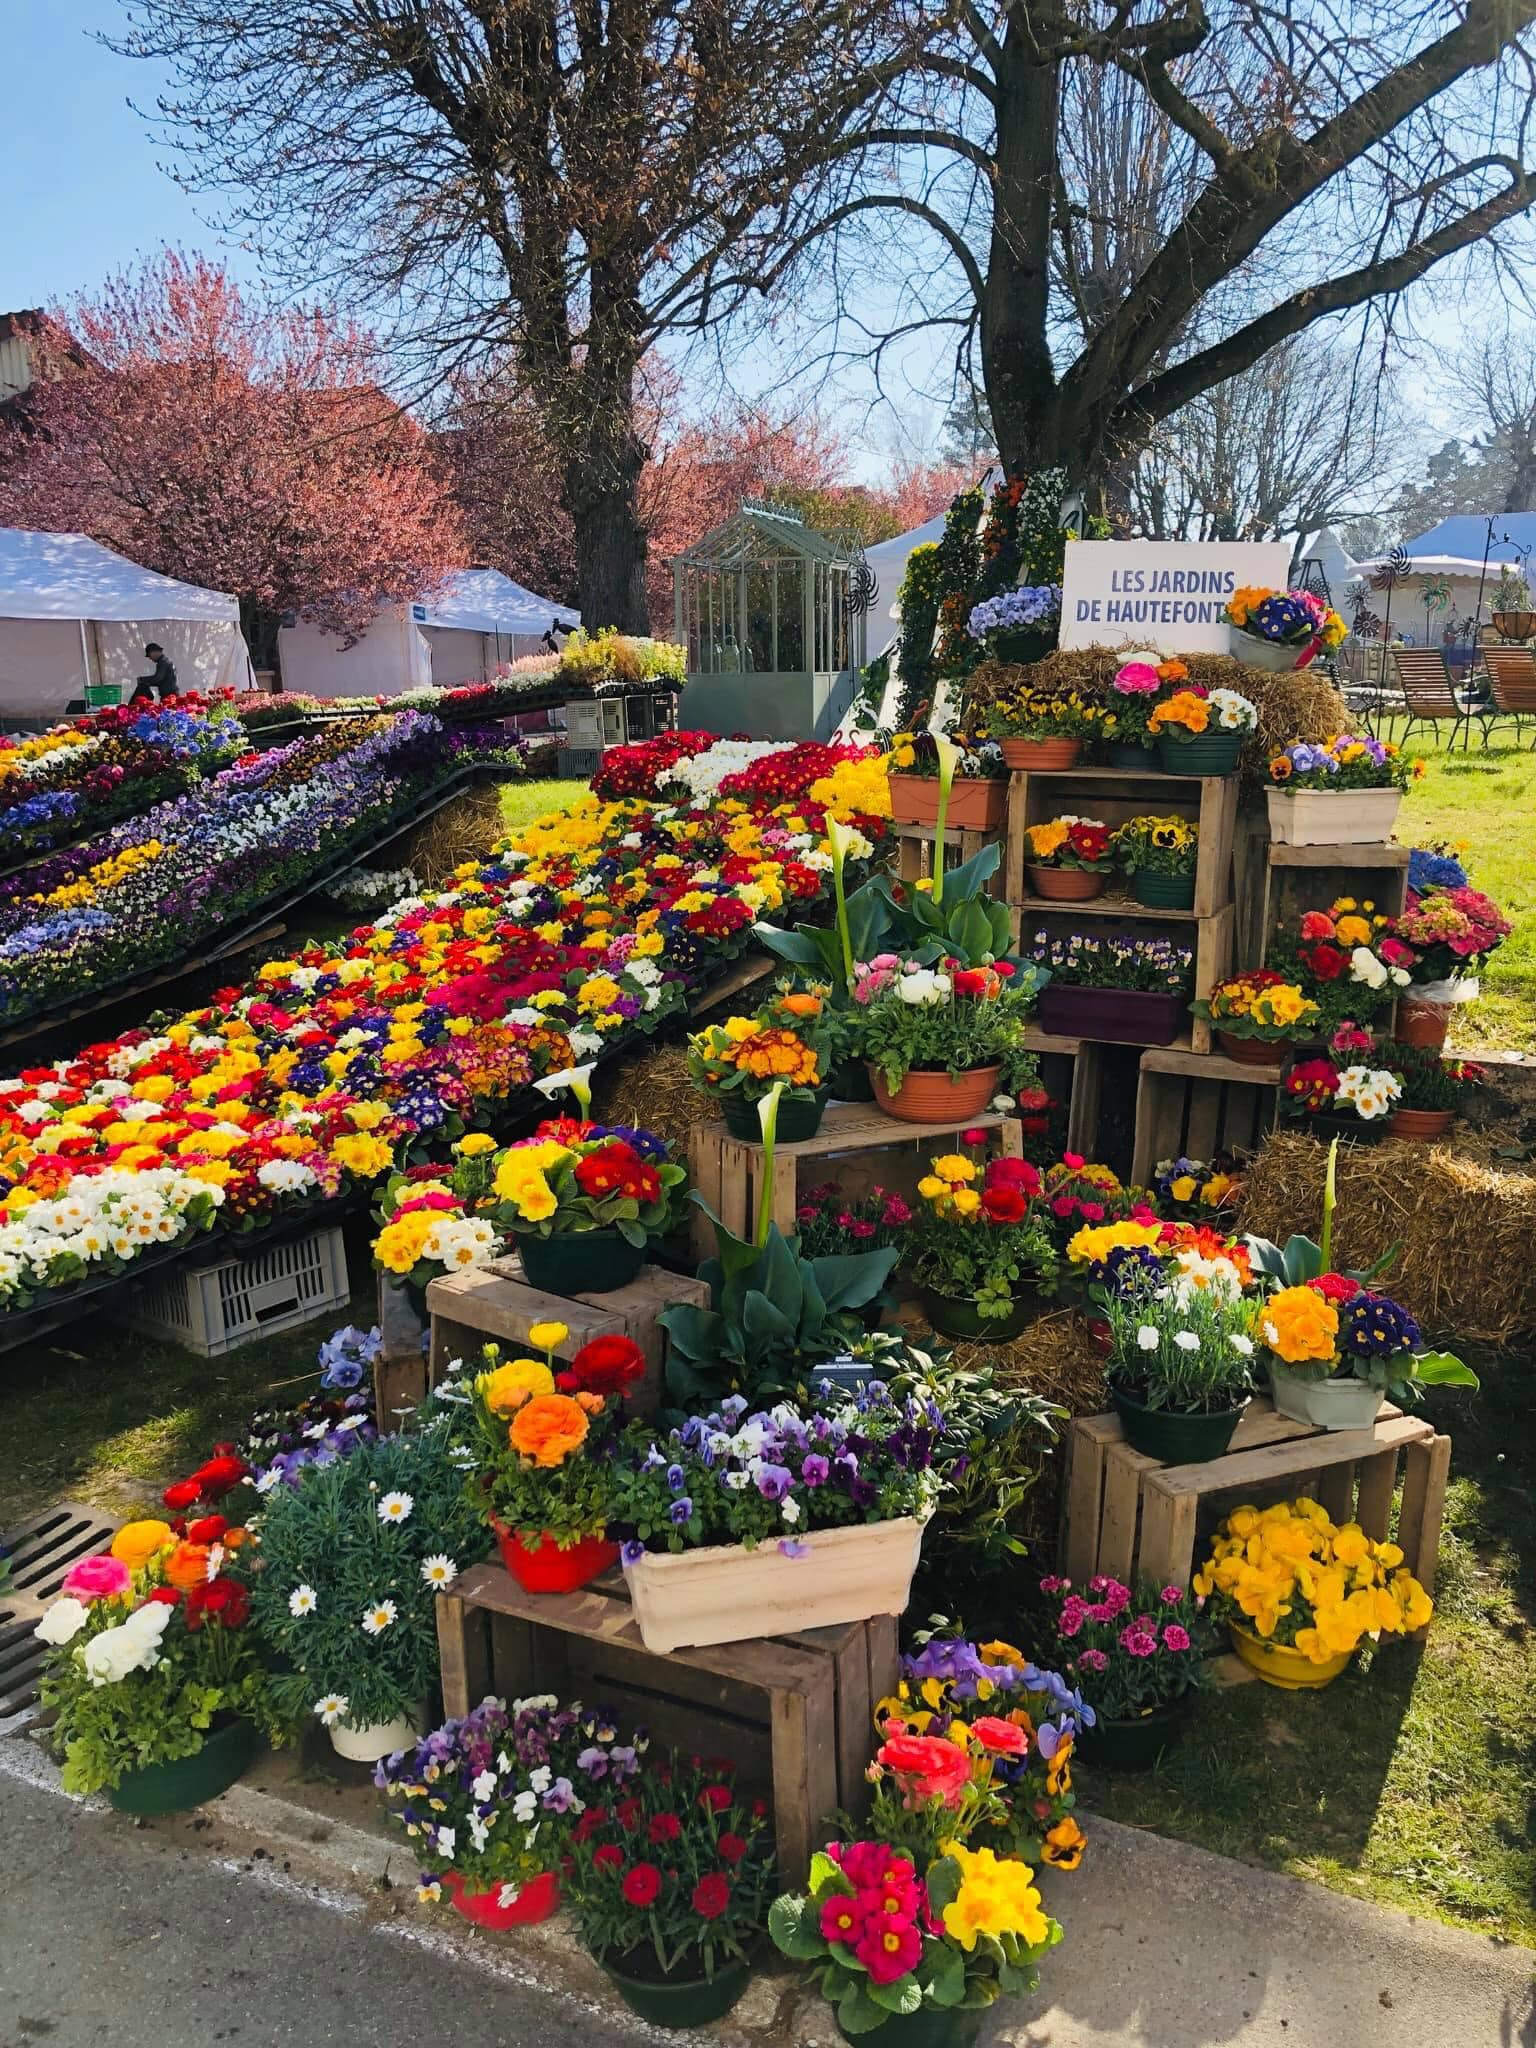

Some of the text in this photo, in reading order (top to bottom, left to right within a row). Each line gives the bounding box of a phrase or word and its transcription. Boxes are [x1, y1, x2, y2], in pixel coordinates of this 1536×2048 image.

[1111, 569, 1235, 594] LES JARDINS
[1076, 599, 1226, 624] DE HAUTEFONT
